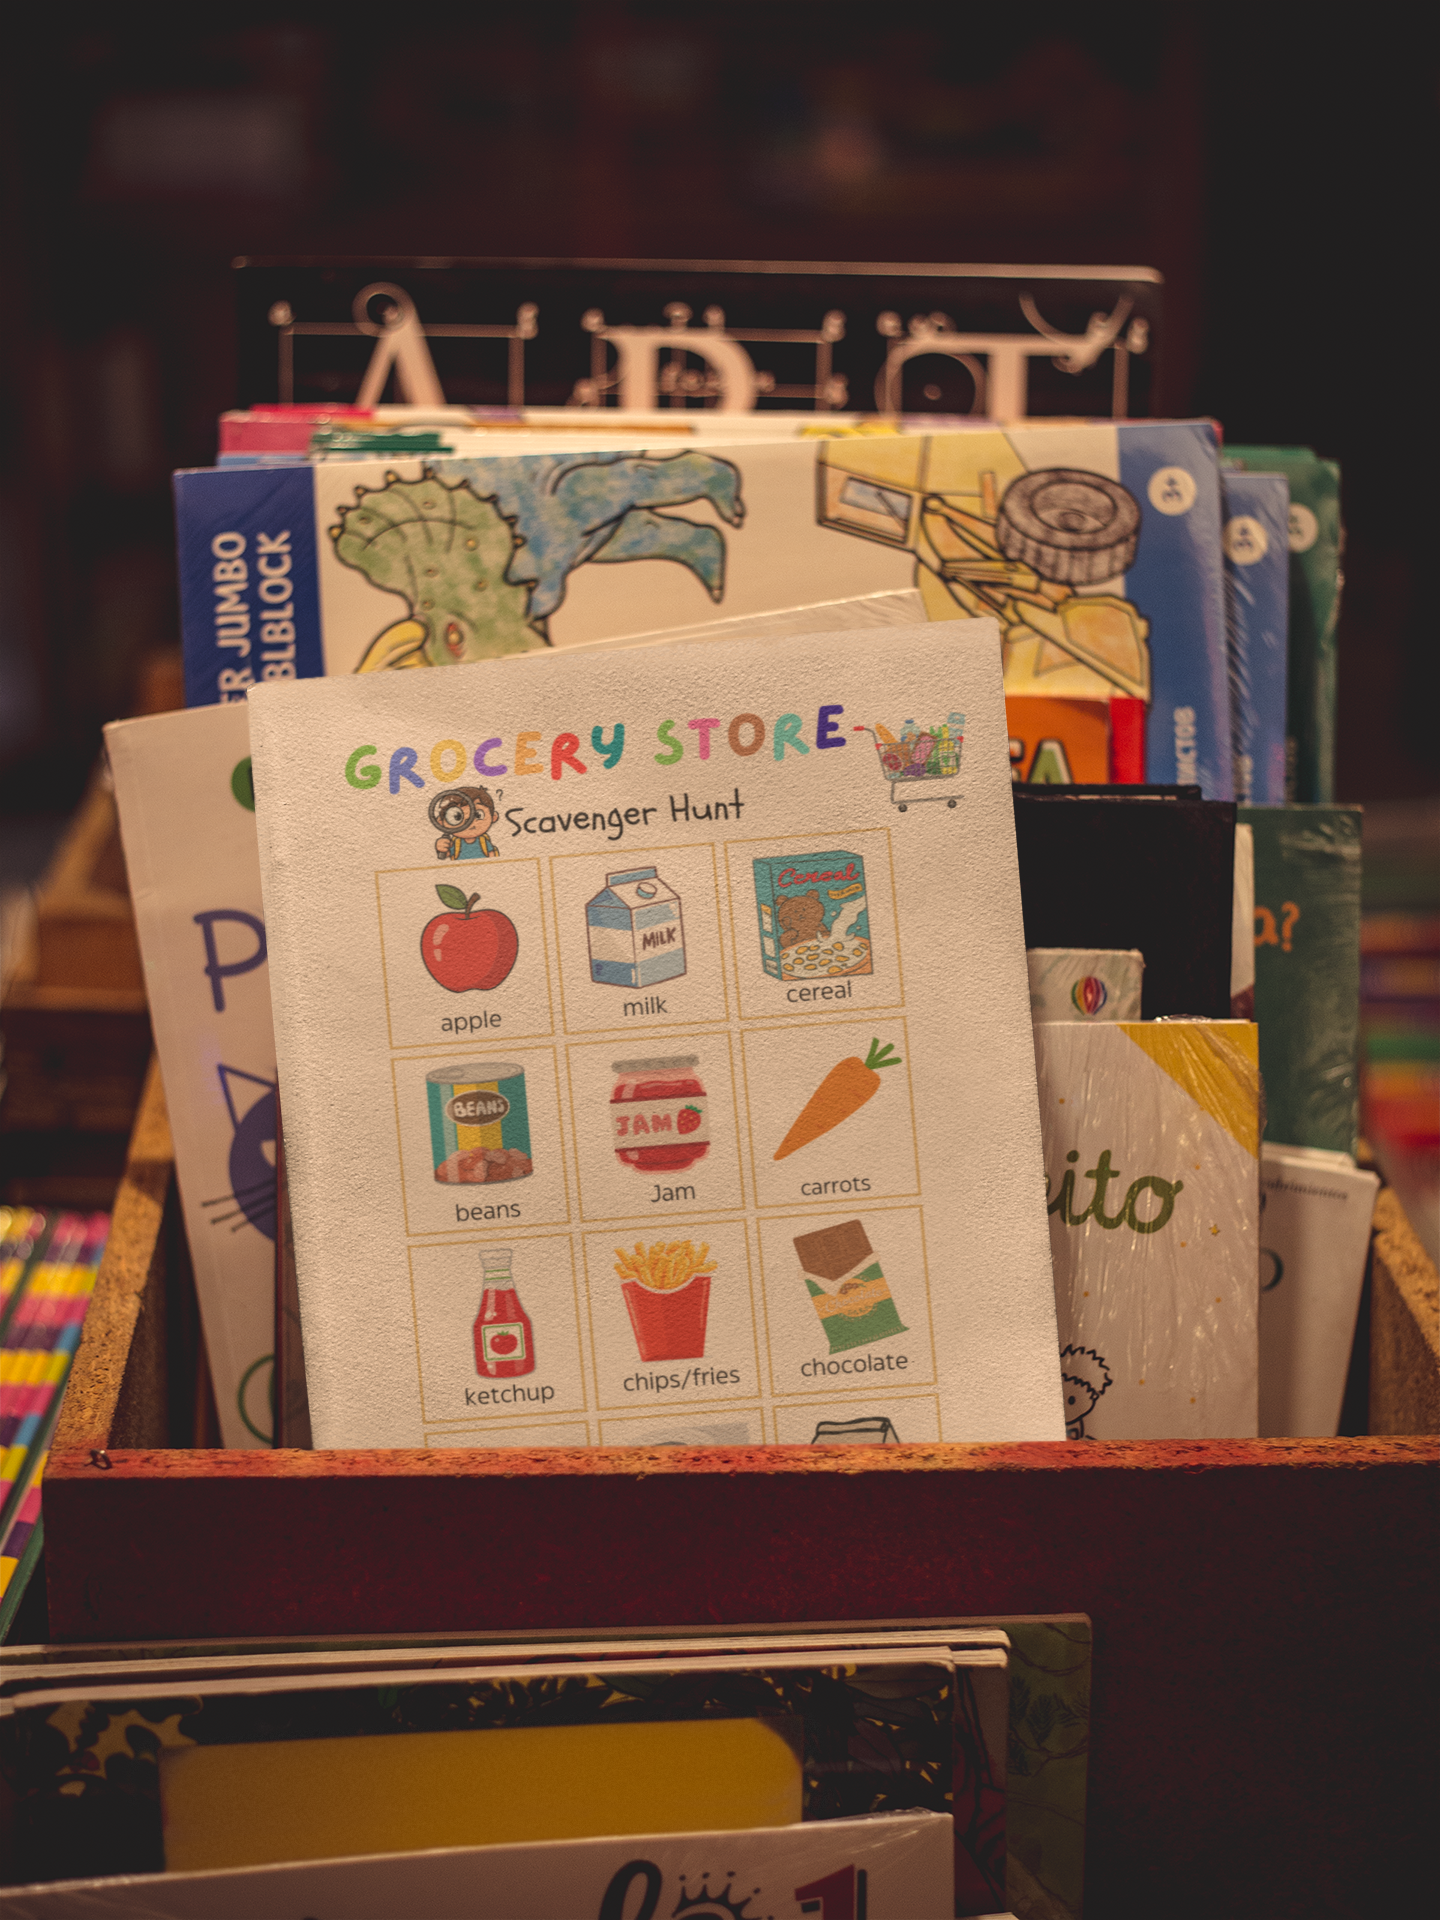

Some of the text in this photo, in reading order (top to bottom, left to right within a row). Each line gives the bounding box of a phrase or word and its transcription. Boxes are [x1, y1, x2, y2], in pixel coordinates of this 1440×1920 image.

[211, 531, 251, 657] JUMBO
[344, 704, 847, 795] GROCERY STORE
[505, 788, 746, 842] Scavenger Hunt
[778, 863, 859, 889] Cereal
[642, 926, 677, 951] MILK
[787, 980, 852, 1004] cereal
[623, 997, 668, 1017] milk
[440, 1011, 503, 1035] apple
[453, 1098, 505, 1118] BEANS
[616, 1113, 673, 1136] JAM
[650, 1184, 696, 1204] Jam
[801, 1177, 872, 1197] carrots
[455, 1202, 522, 1223] beans
[800, 1353, 909, 1377] chocolate
[623, 1366, 741, 1394] chips/fries
[465, 1384, 555, 1407] ketchup
